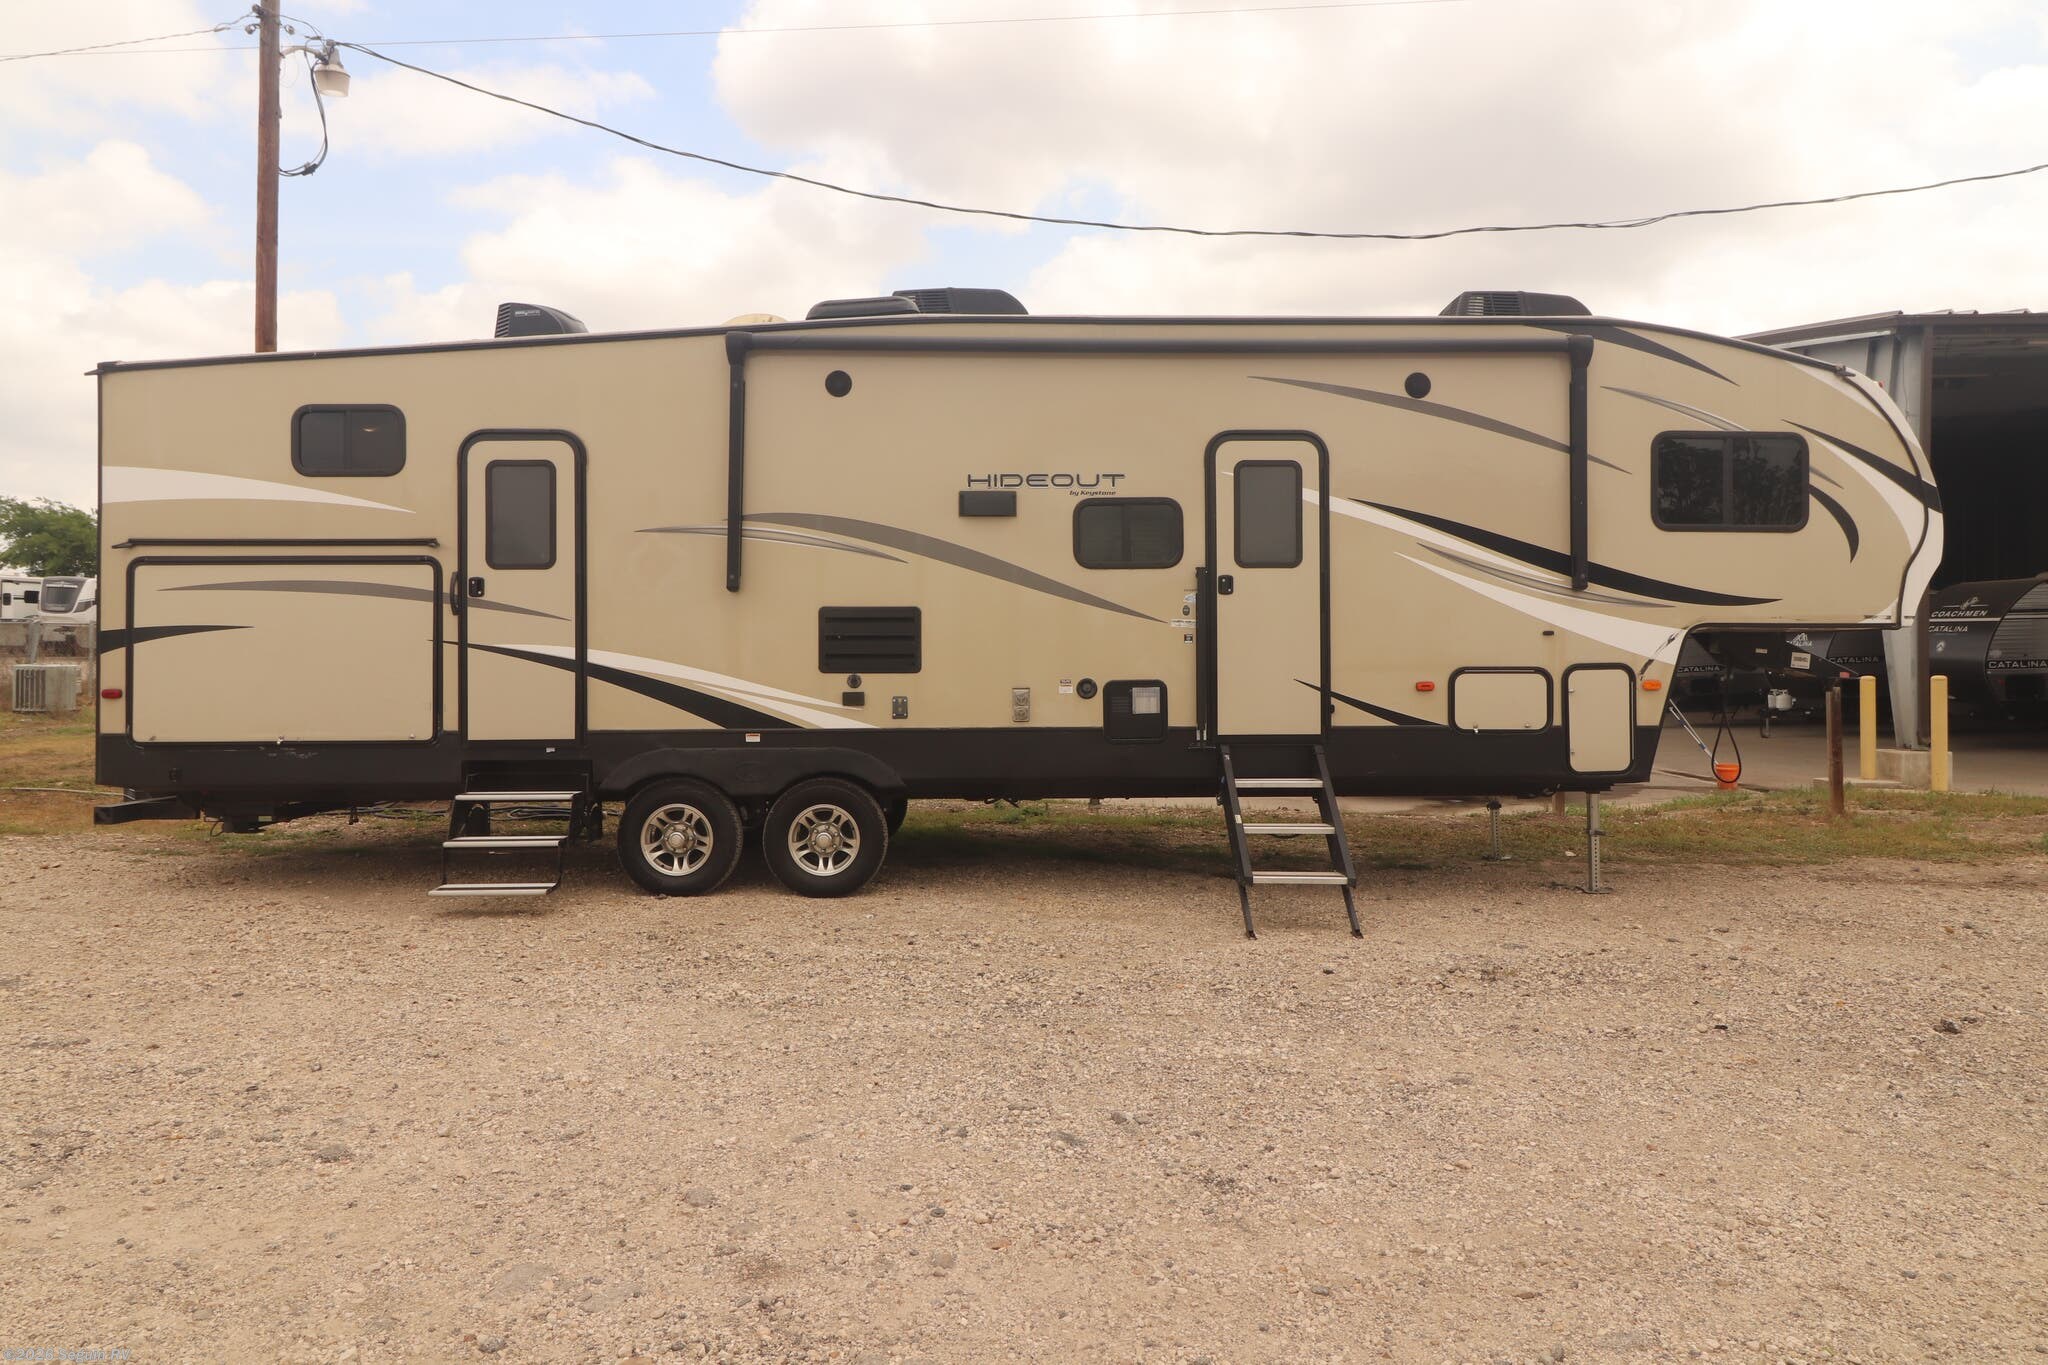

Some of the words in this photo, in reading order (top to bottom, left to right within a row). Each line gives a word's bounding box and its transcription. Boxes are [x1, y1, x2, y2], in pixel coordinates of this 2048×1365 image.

[968, 474, 1125, 487] HIDEOUT
[1829, 656, 1879, 664] CATALINA
[1988, 660, 2048, 669] CATALINA
[1678, 665, 1720, 673] CATALINA
